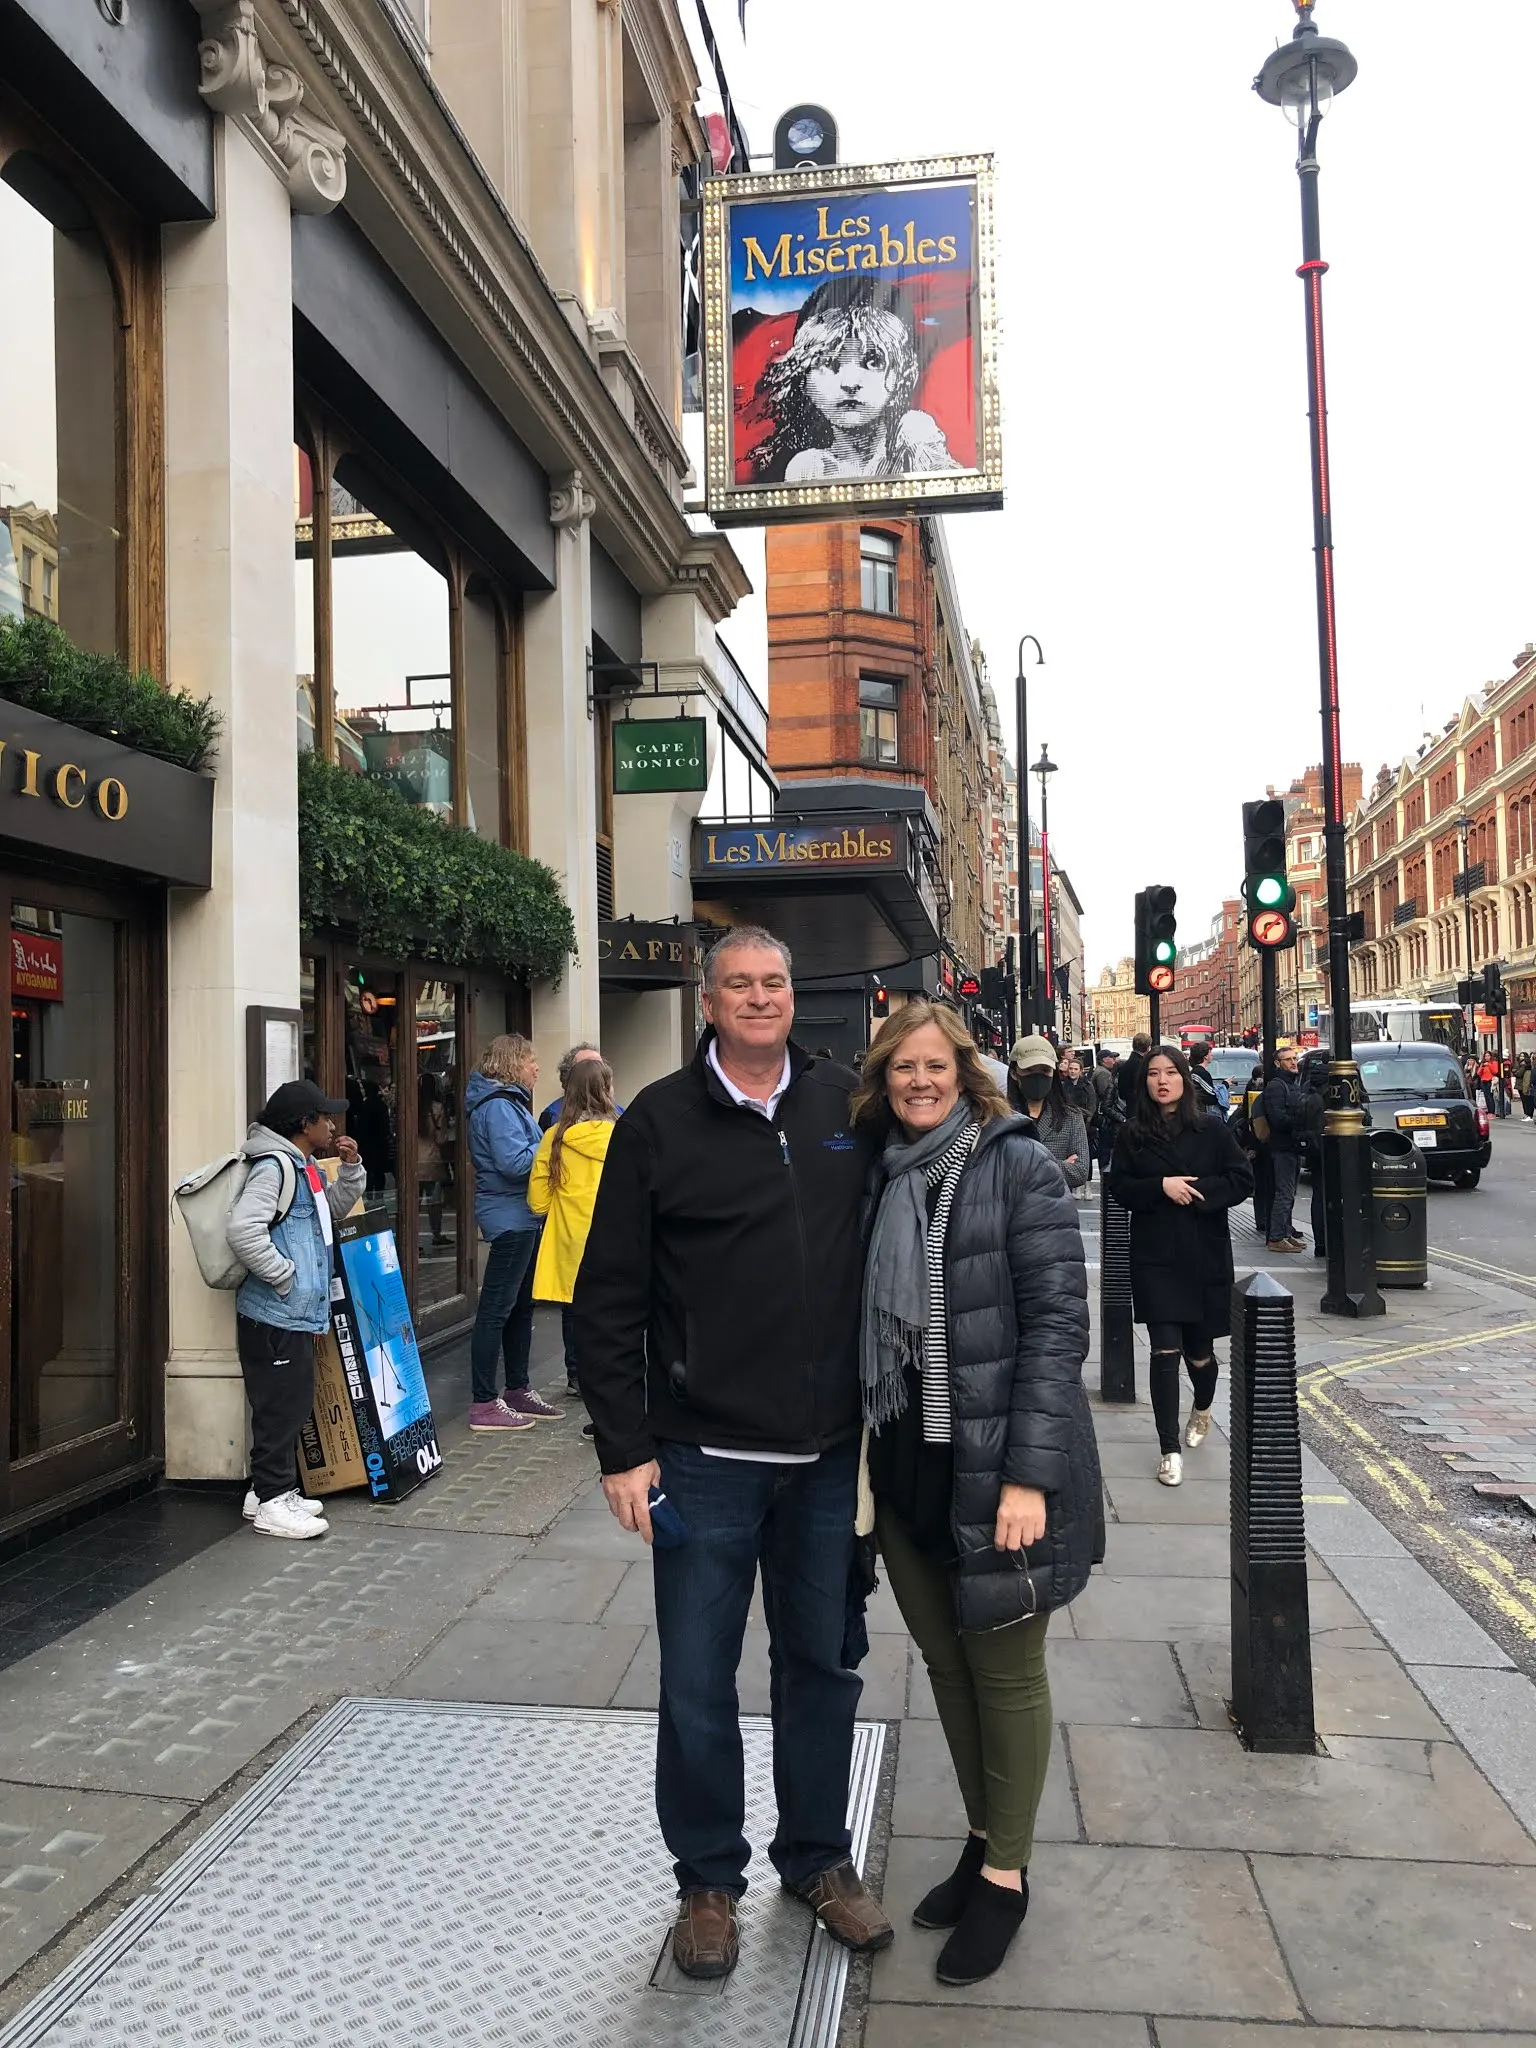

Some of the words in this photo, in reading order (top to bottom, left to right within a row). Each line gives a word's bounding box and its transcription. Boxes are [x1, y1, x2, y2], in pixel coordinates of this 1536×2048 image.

[816, 206, 871, 241] Les
[742, 221, 957, 281] Misérables
[620, 757, 700, 769] MONICO
[635, 743, 684, 754] CAFE
[0, 741, 129, 820] ICO
[707, 835, 751, 864] Les
[754, 828, 892, 862] Misérables
[598, 939, 683, 962] CAFE
[67, 1099, 88, 1119] FIXE
[403, 1399, 430, 1424] STAND
[369, 1426, 381, 1452] STAND
[388, 1413, 433, 1453] KEYBOARD
[391, 1428, 435, 1468] ADJUSTABLE
[416, 1440, 442, 1474] T10
[366, 1452, 389, 1497] T10
